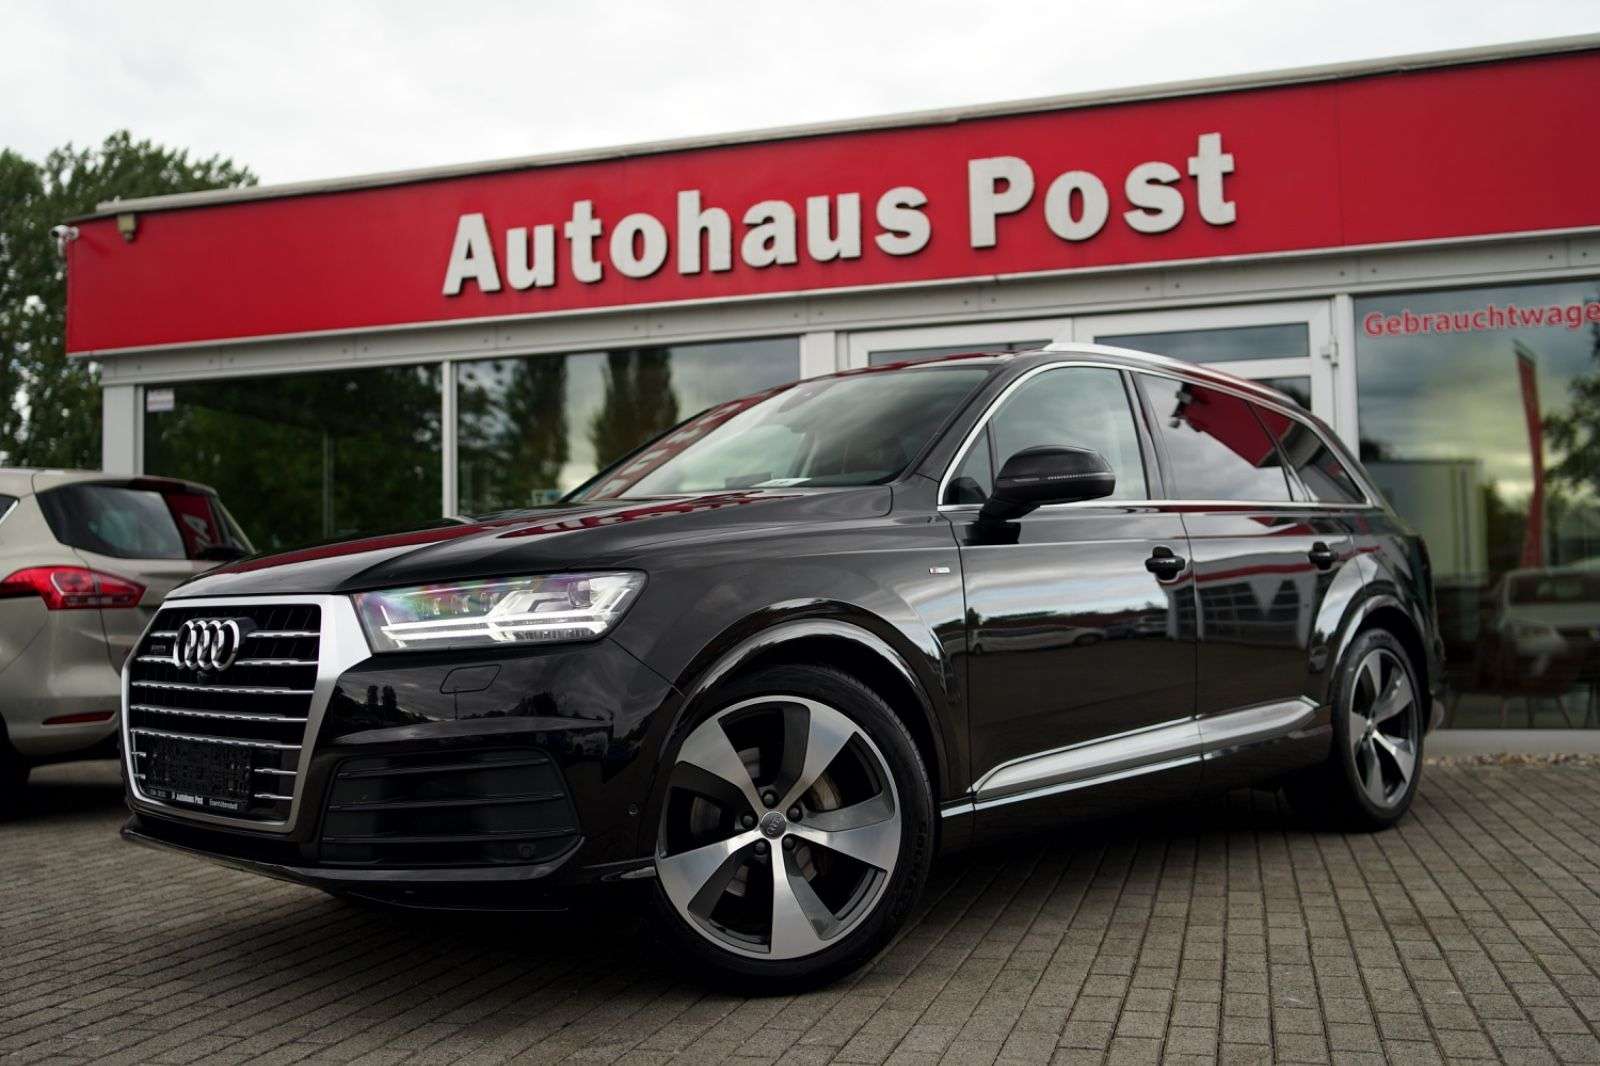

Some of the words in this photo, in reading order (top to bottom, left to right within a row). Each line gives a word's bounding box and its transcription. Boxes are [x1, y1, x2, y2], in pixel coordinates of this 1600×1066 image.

[442, 186, 932, 297] Autohaus
[968, 132, 1238, 249] Post
[1364, 302, 1600, 337] Gebrauchtwage
